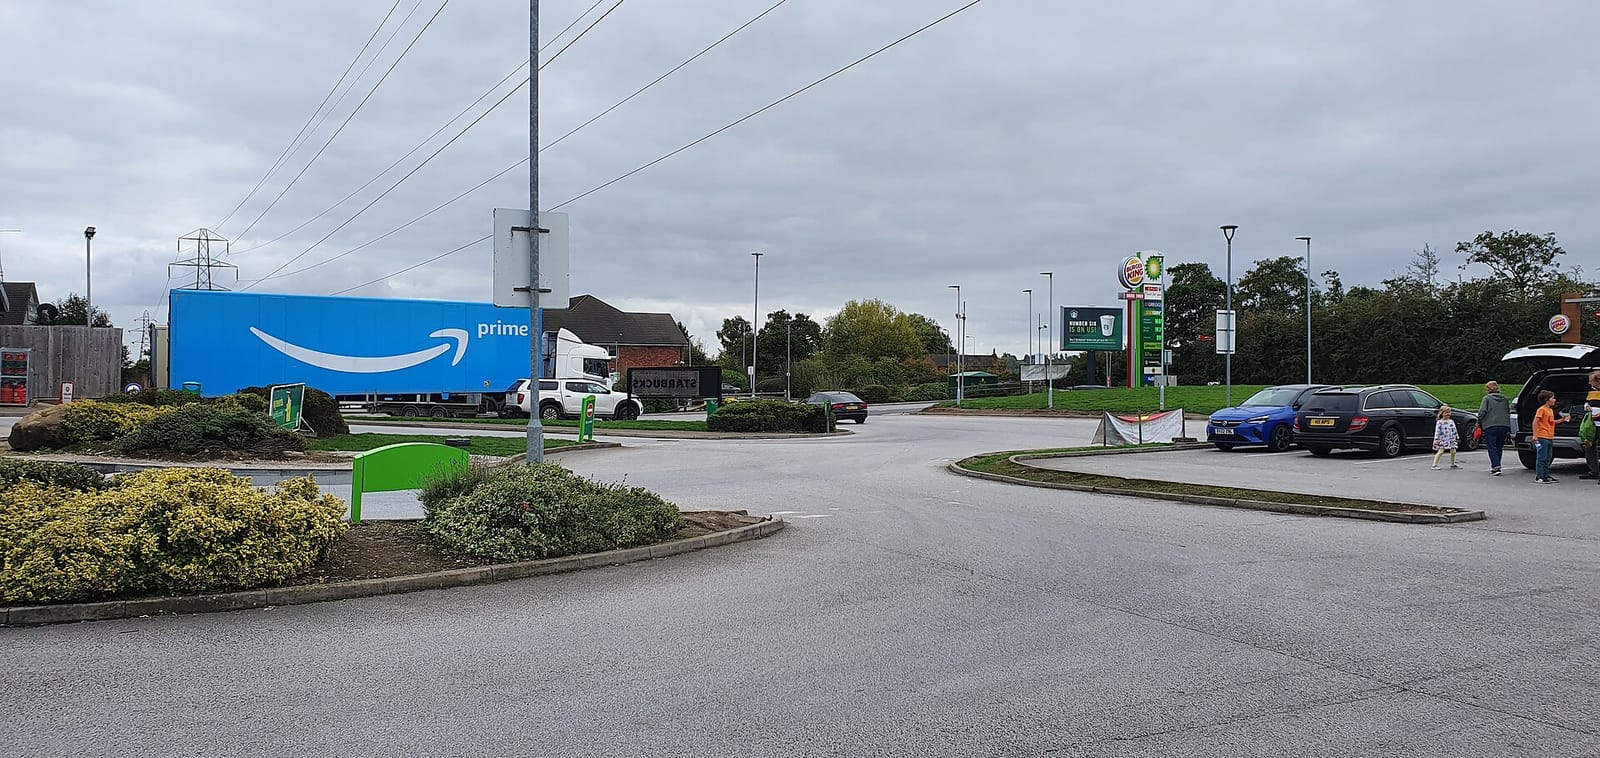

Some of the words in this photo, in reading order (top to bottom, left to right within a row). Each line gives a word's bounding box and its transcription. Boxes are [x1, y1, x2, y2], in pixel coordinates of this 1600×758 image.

[1126, 263, 1142, 272] BURGER
[1127, 269, 1143, 279] KING
[478, 320, 528, 338] prime
